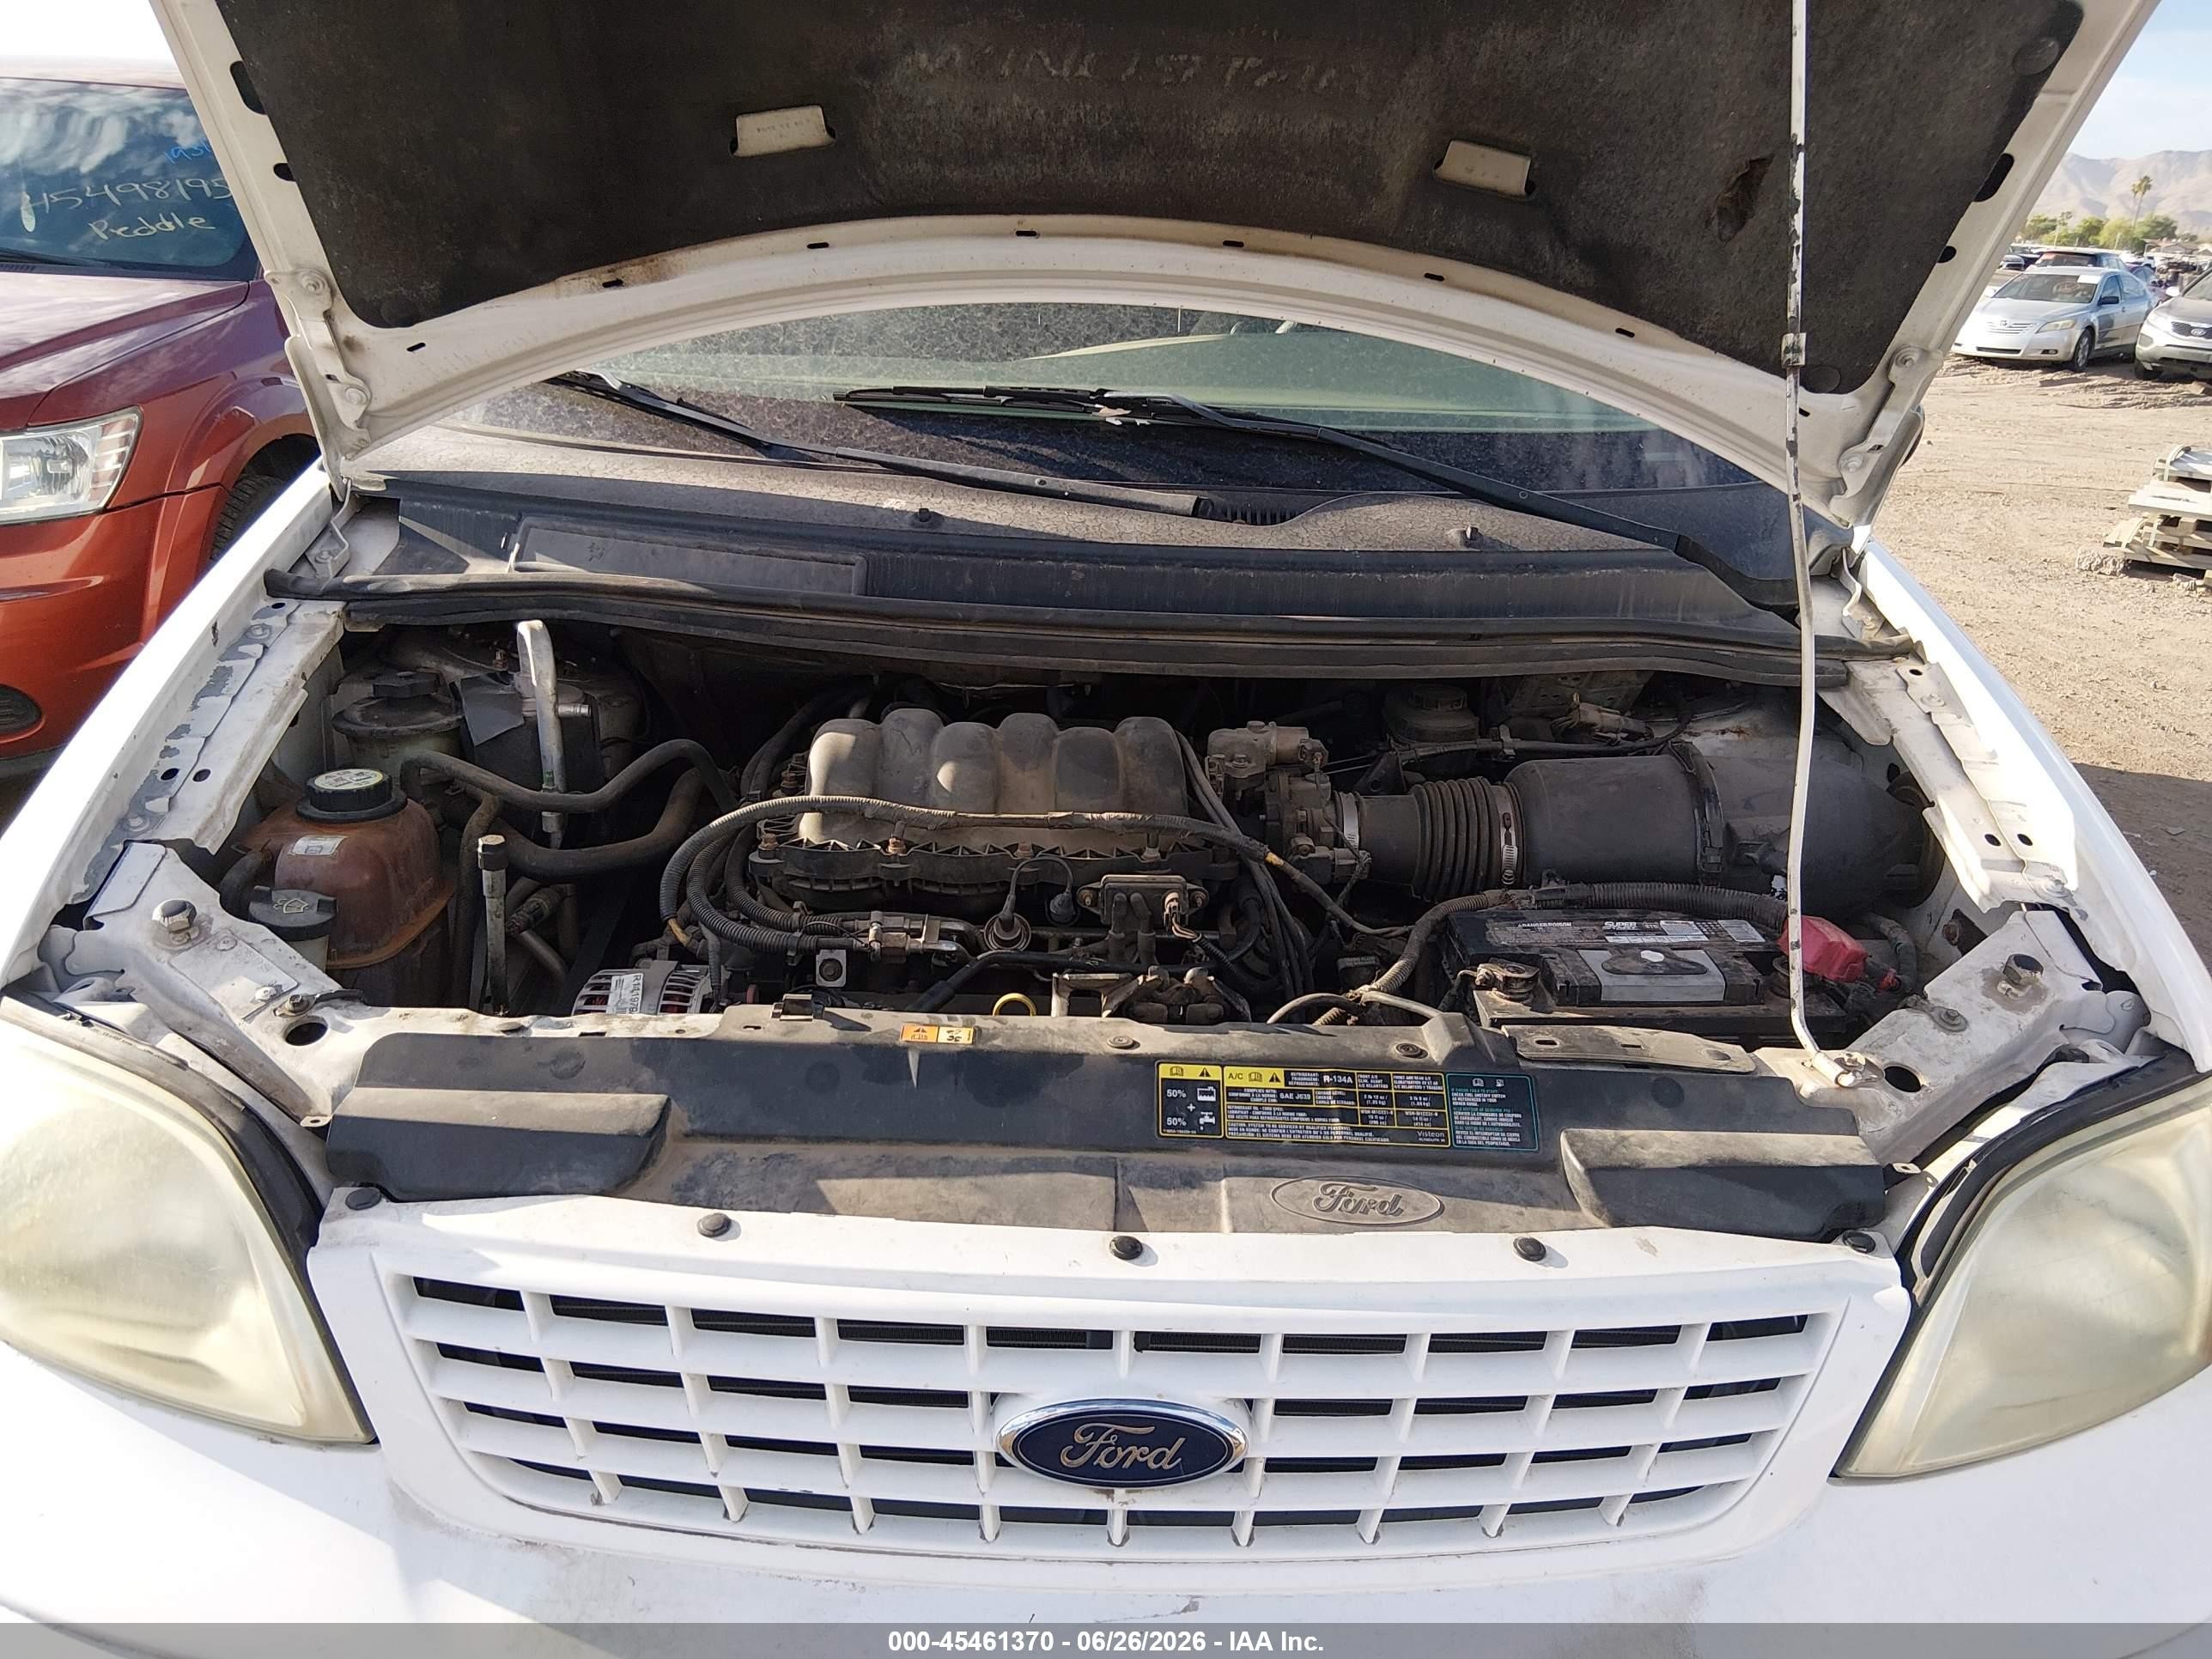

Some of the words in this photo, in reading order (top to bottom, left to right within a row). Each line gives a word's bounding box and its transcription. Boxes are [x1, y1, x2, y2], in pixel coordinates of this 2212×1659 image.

[1323, 1075, 1353, 1084] R-134A
[1167, 1089, 1186, 1098] 50%
[1167, 1117, 1186, 1126] 50%
[1313, 1182, 1405, 1217] Ford
[1060, 1423, 1185, 1470] Ford
